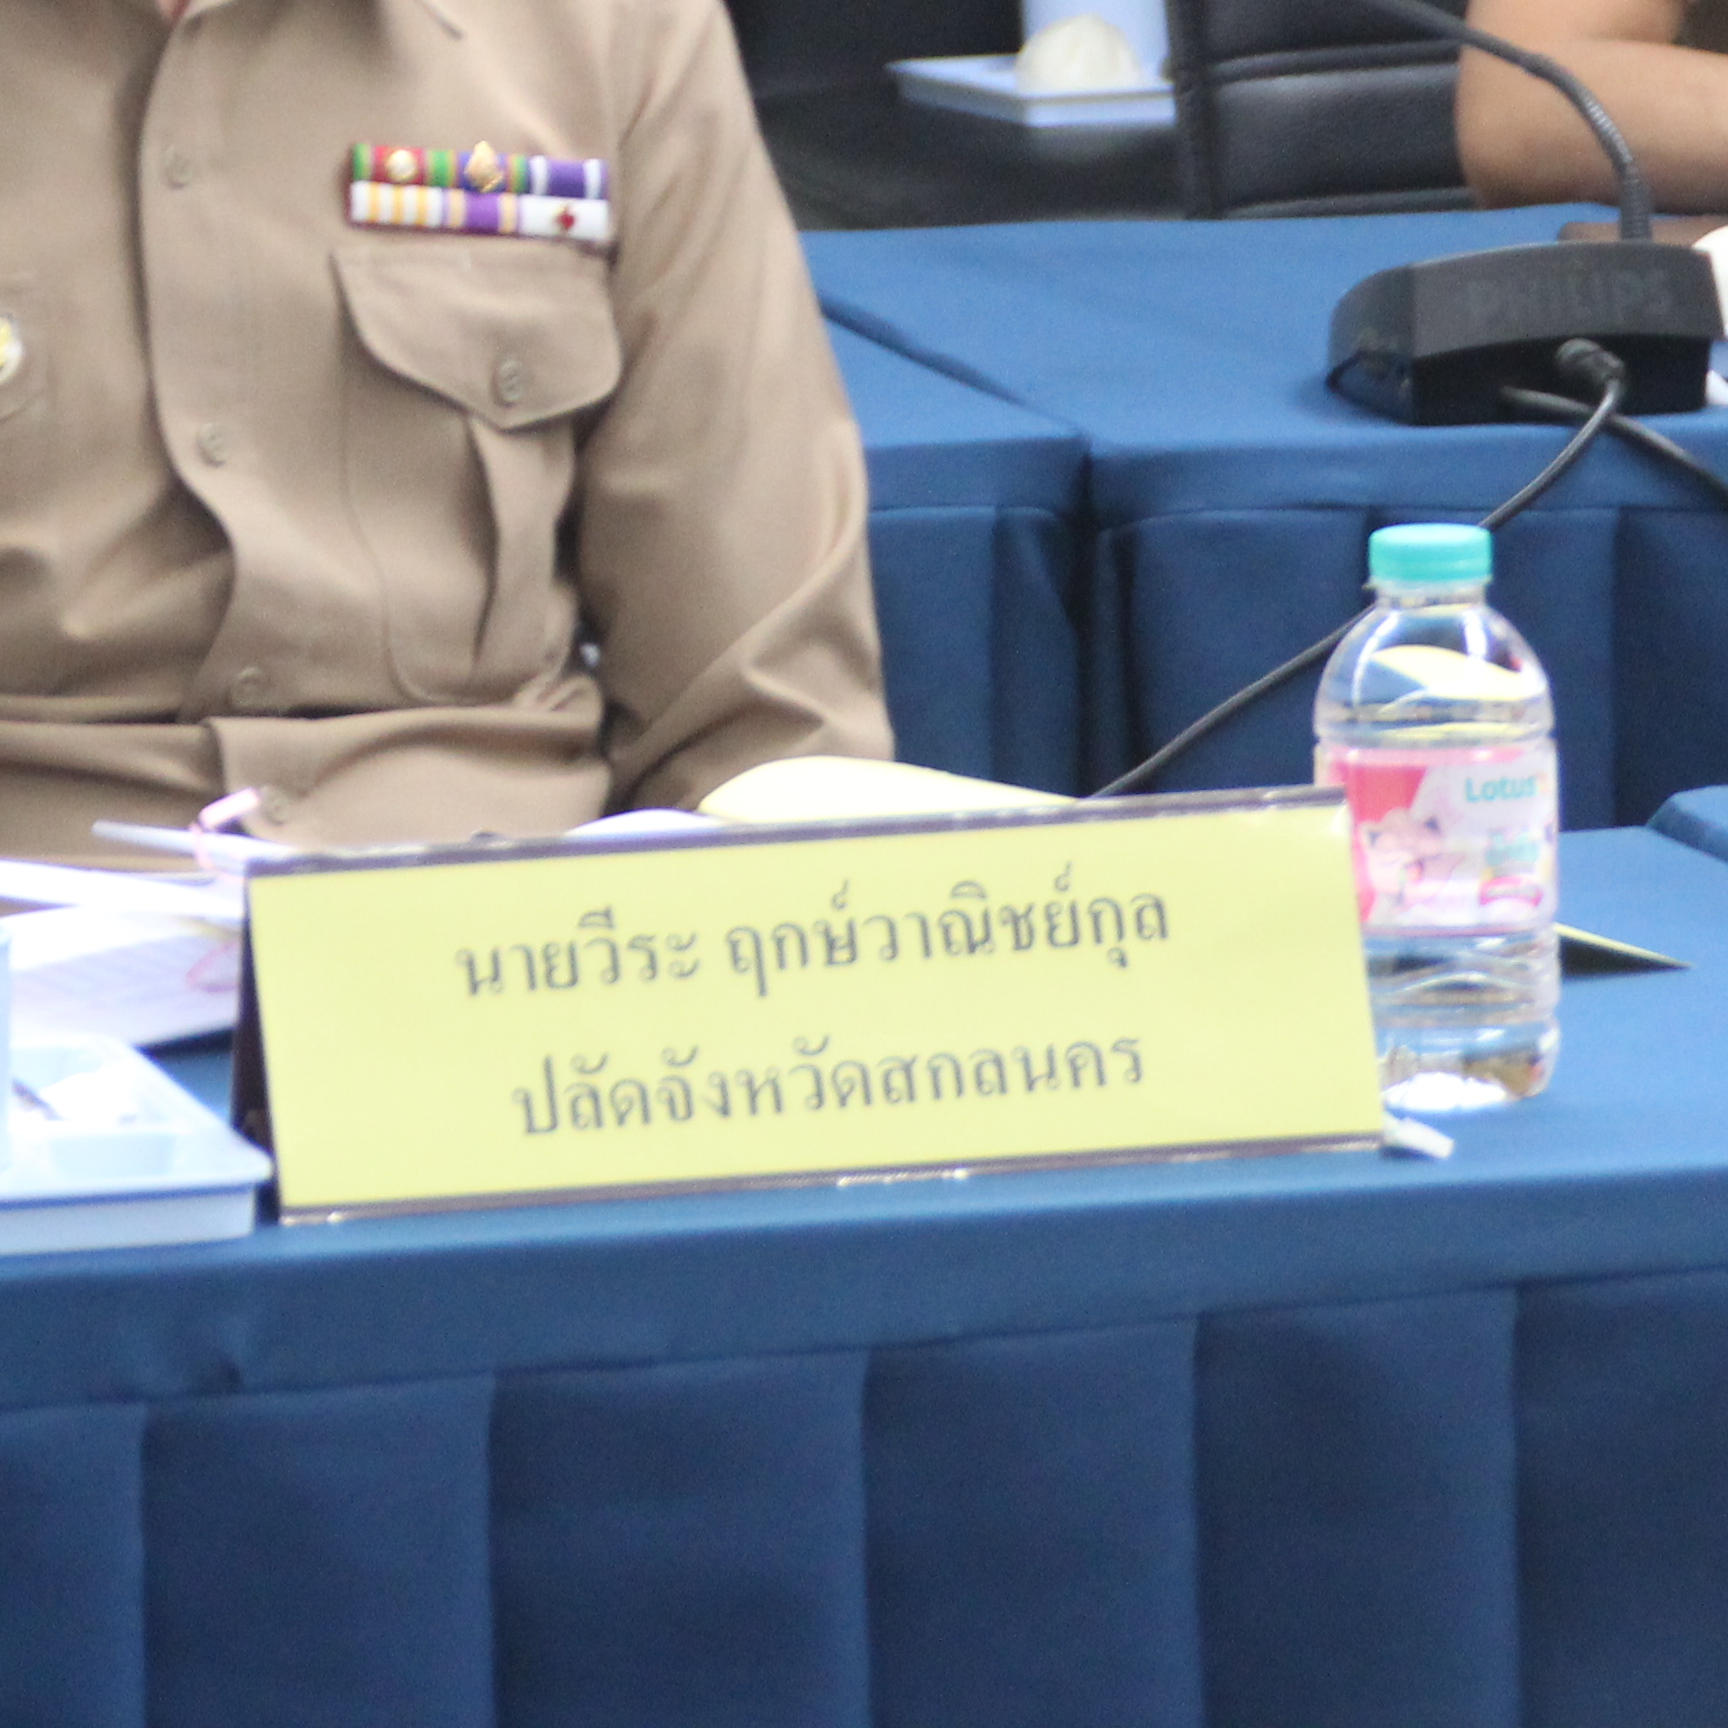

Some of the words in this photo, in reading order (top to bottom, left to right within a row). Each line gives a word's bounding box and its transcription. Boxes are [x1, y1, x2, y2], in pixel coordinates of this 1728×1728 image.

[455, 906, 700, 997] นายวีระ
[511, 1032, 1146, 1138] ปลัดจังหวัดสกลนคร
